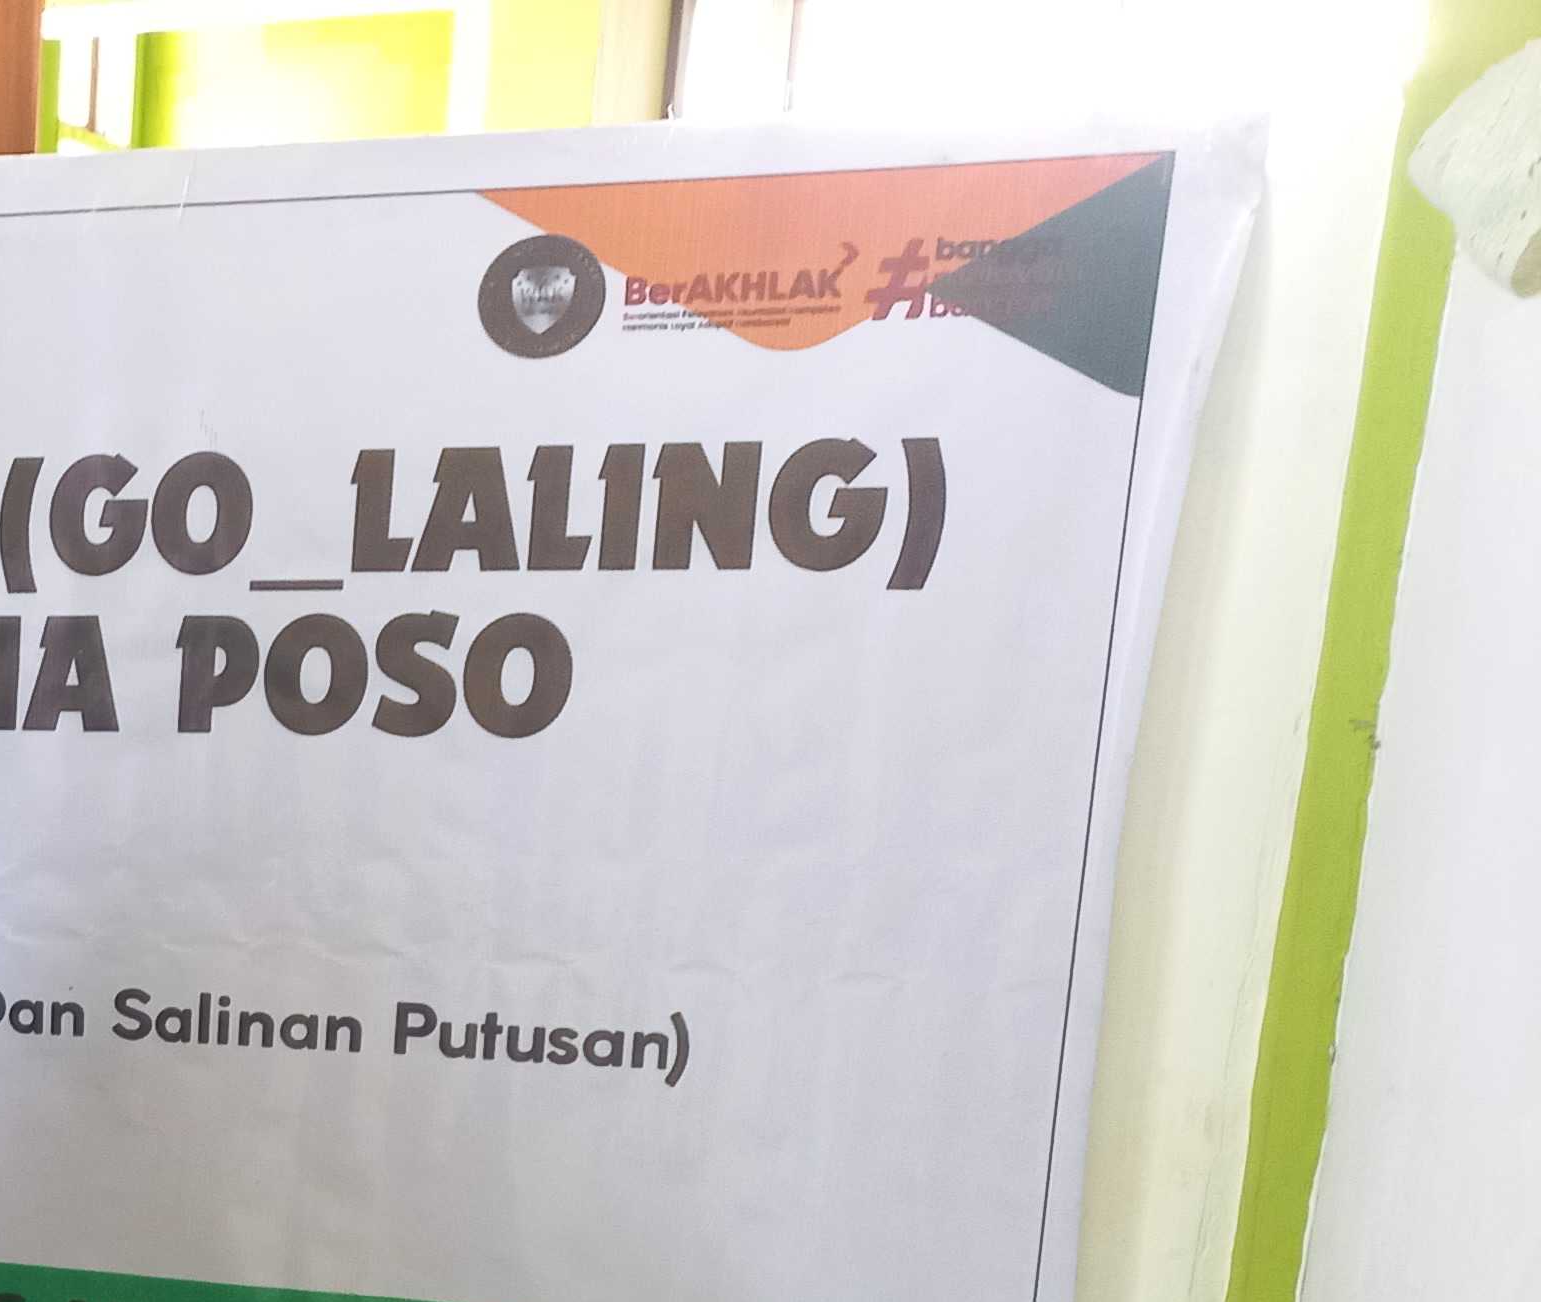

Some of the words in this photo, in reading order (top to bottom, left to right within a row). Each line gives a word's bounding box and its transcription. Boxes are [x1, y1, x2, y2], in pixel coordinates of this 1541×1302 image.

[623, 267, 843, 306] BerAKHLAK
[175, 609, 573, 739] POSO
[112, 988, 362, 1054] Salinan
[394, 1001, 690, 1088] Putusan)
